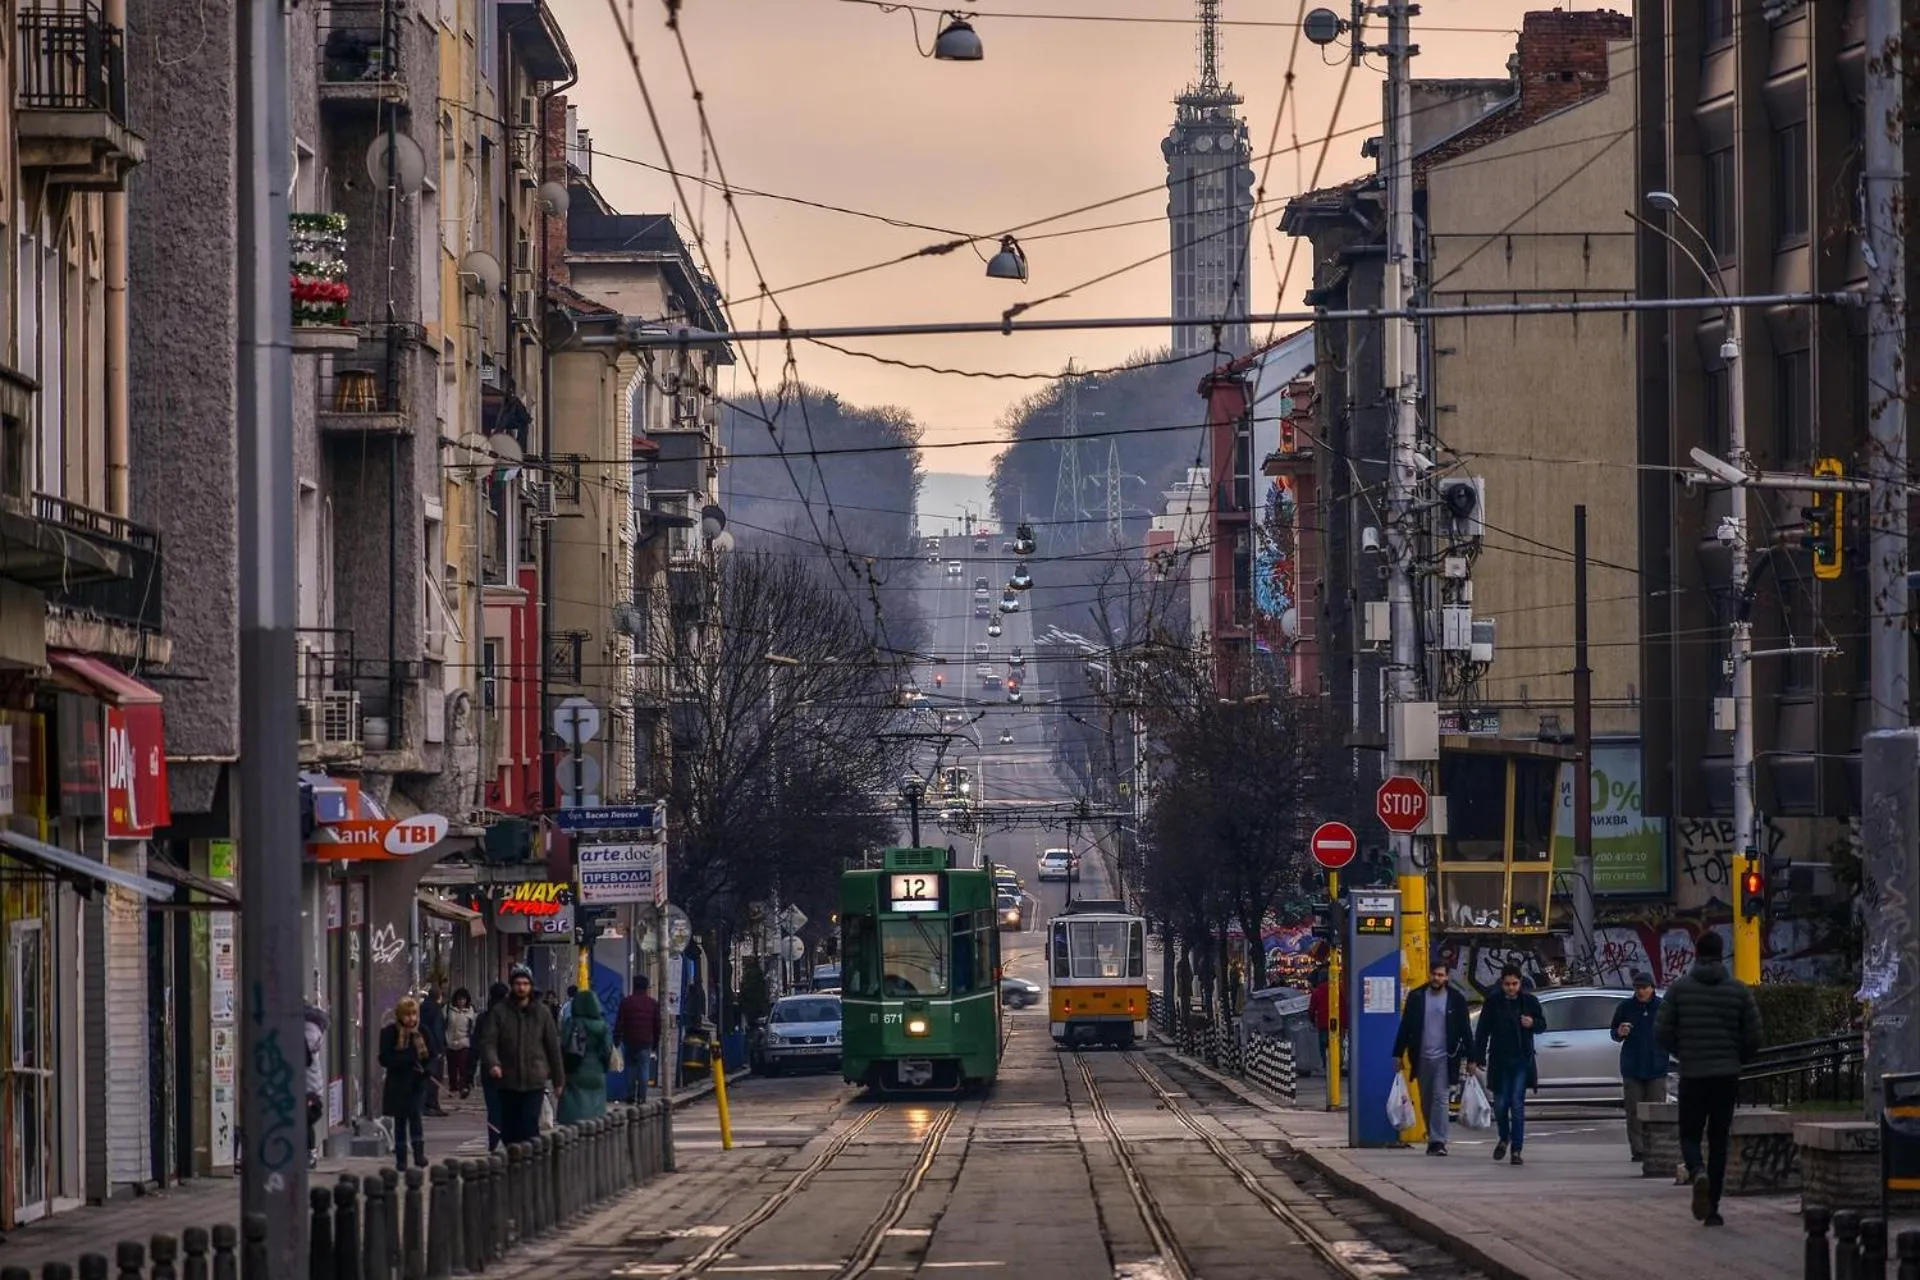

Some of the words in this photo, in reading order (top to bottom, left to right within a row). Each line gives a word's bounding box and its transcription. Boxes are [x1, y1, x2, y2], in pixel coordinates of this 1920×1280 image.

[1383, 793, 1423, 816] STOP
[585, 811, 609, 819] Васил
[396, 825, 436, 844] TBI
[583, 871, 650, 883] ПРЕВОДИ
[903, 878, 926, 899] 12
[883, 1013, 903, 1024] 671
